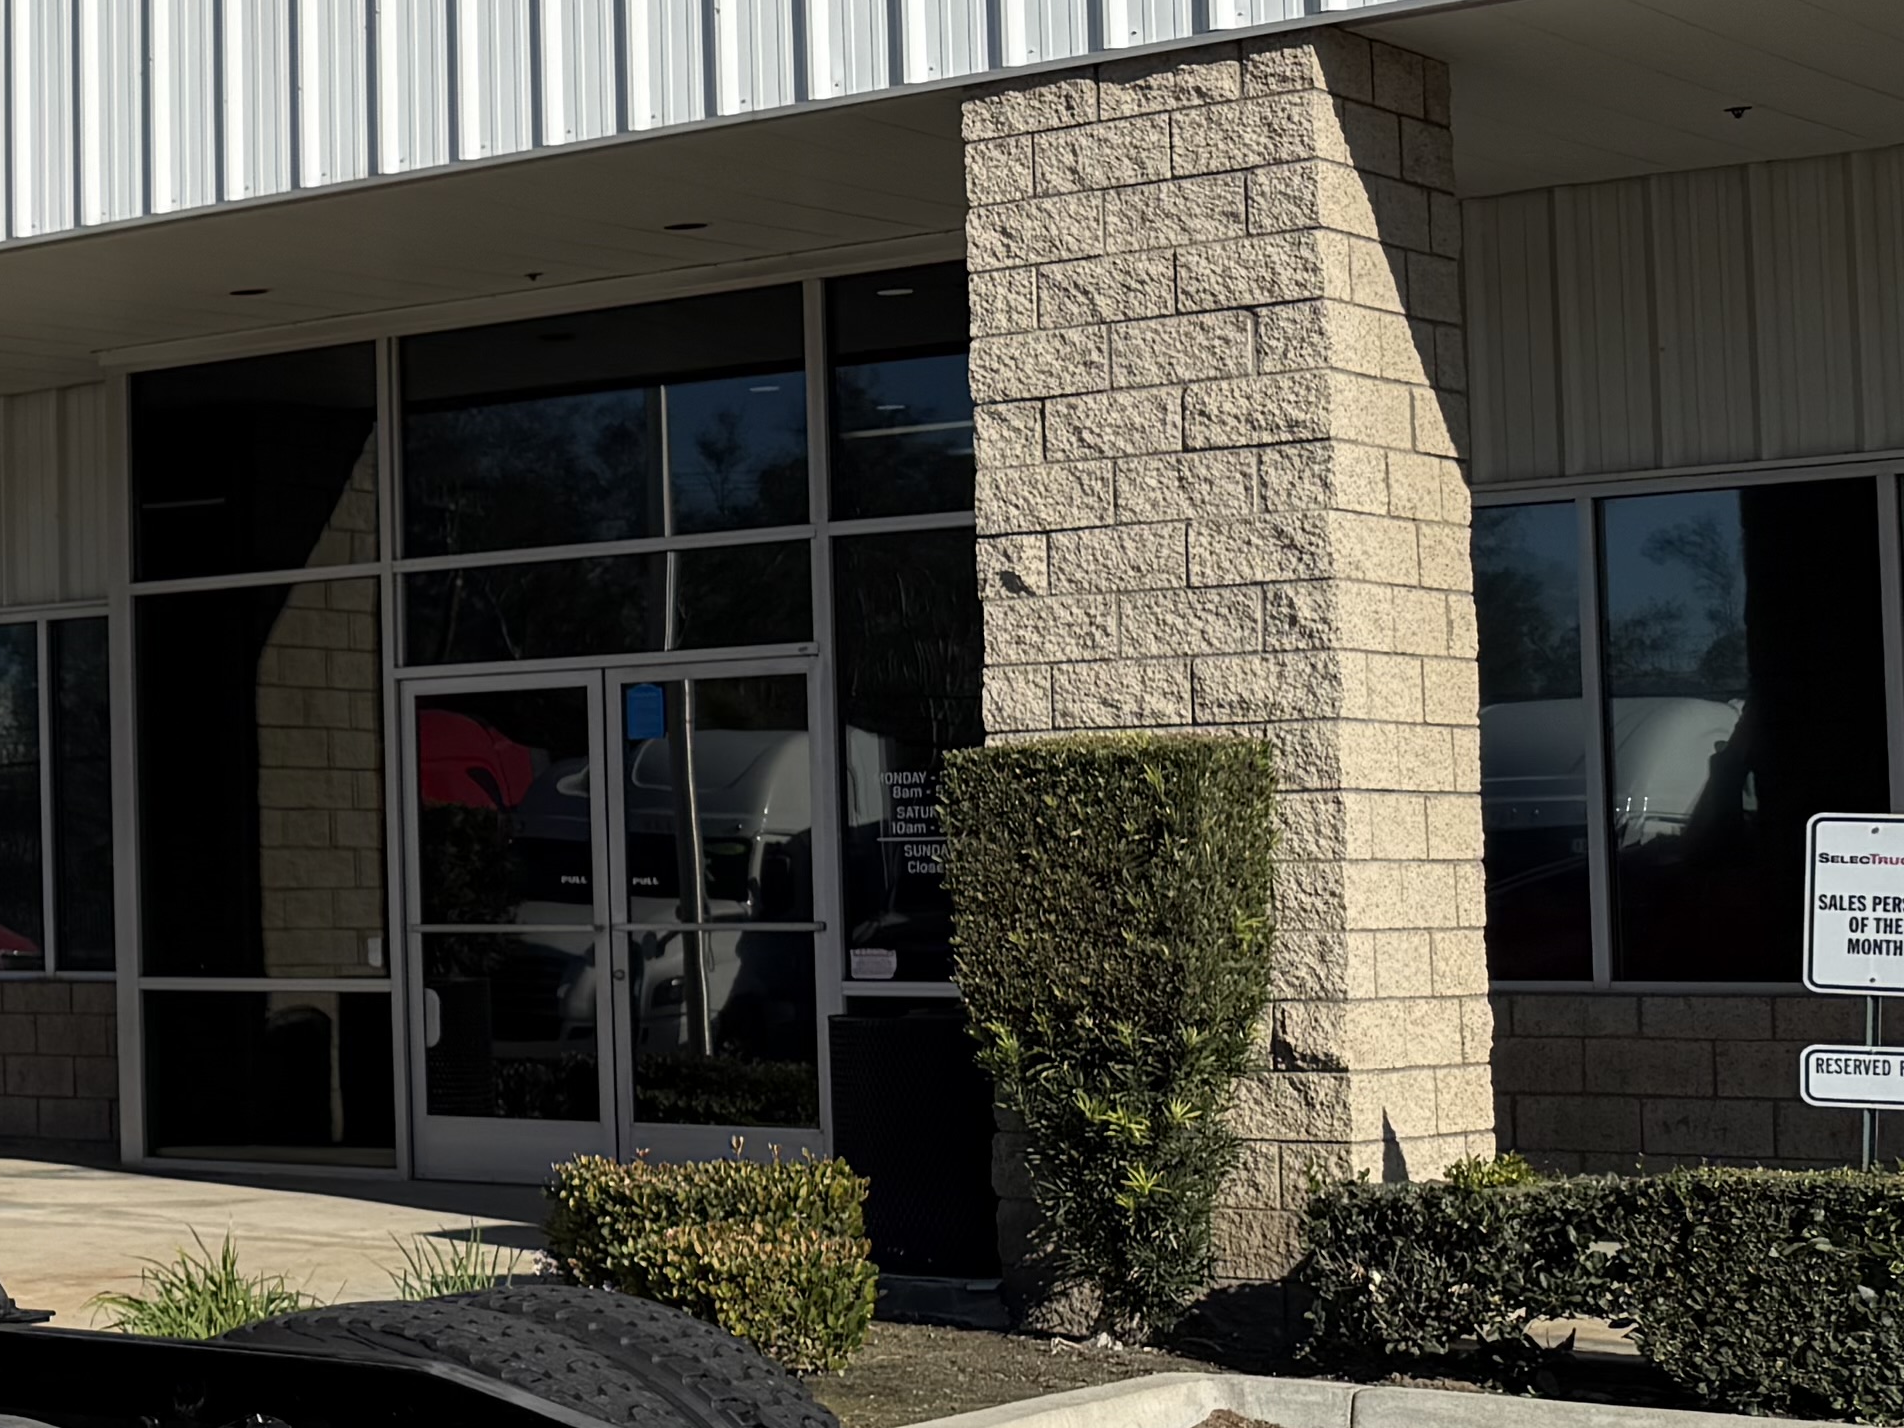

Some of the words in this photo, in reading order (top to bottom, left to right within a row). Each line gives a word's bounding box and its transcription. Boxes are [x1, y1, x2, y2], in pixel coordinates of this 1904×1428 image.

[892, 785, 923, 799] 8am
[896, 805, 939, 819] SATUR
[892, 821, 927, 835] 10am
[904, 844, 951, 858] SUNDA
[908, 860, 944, 874] Close
[1818, 894, 1867, 912] SALES
[1872, 896, 1904, 913] PER
[1849, 916, 1869, 933] OF
[1873, 917, 1903, 934] THE
[1847, 938, 1903, 956] MONTH
[1816, 1057, 1891, 1076] RESERVED
